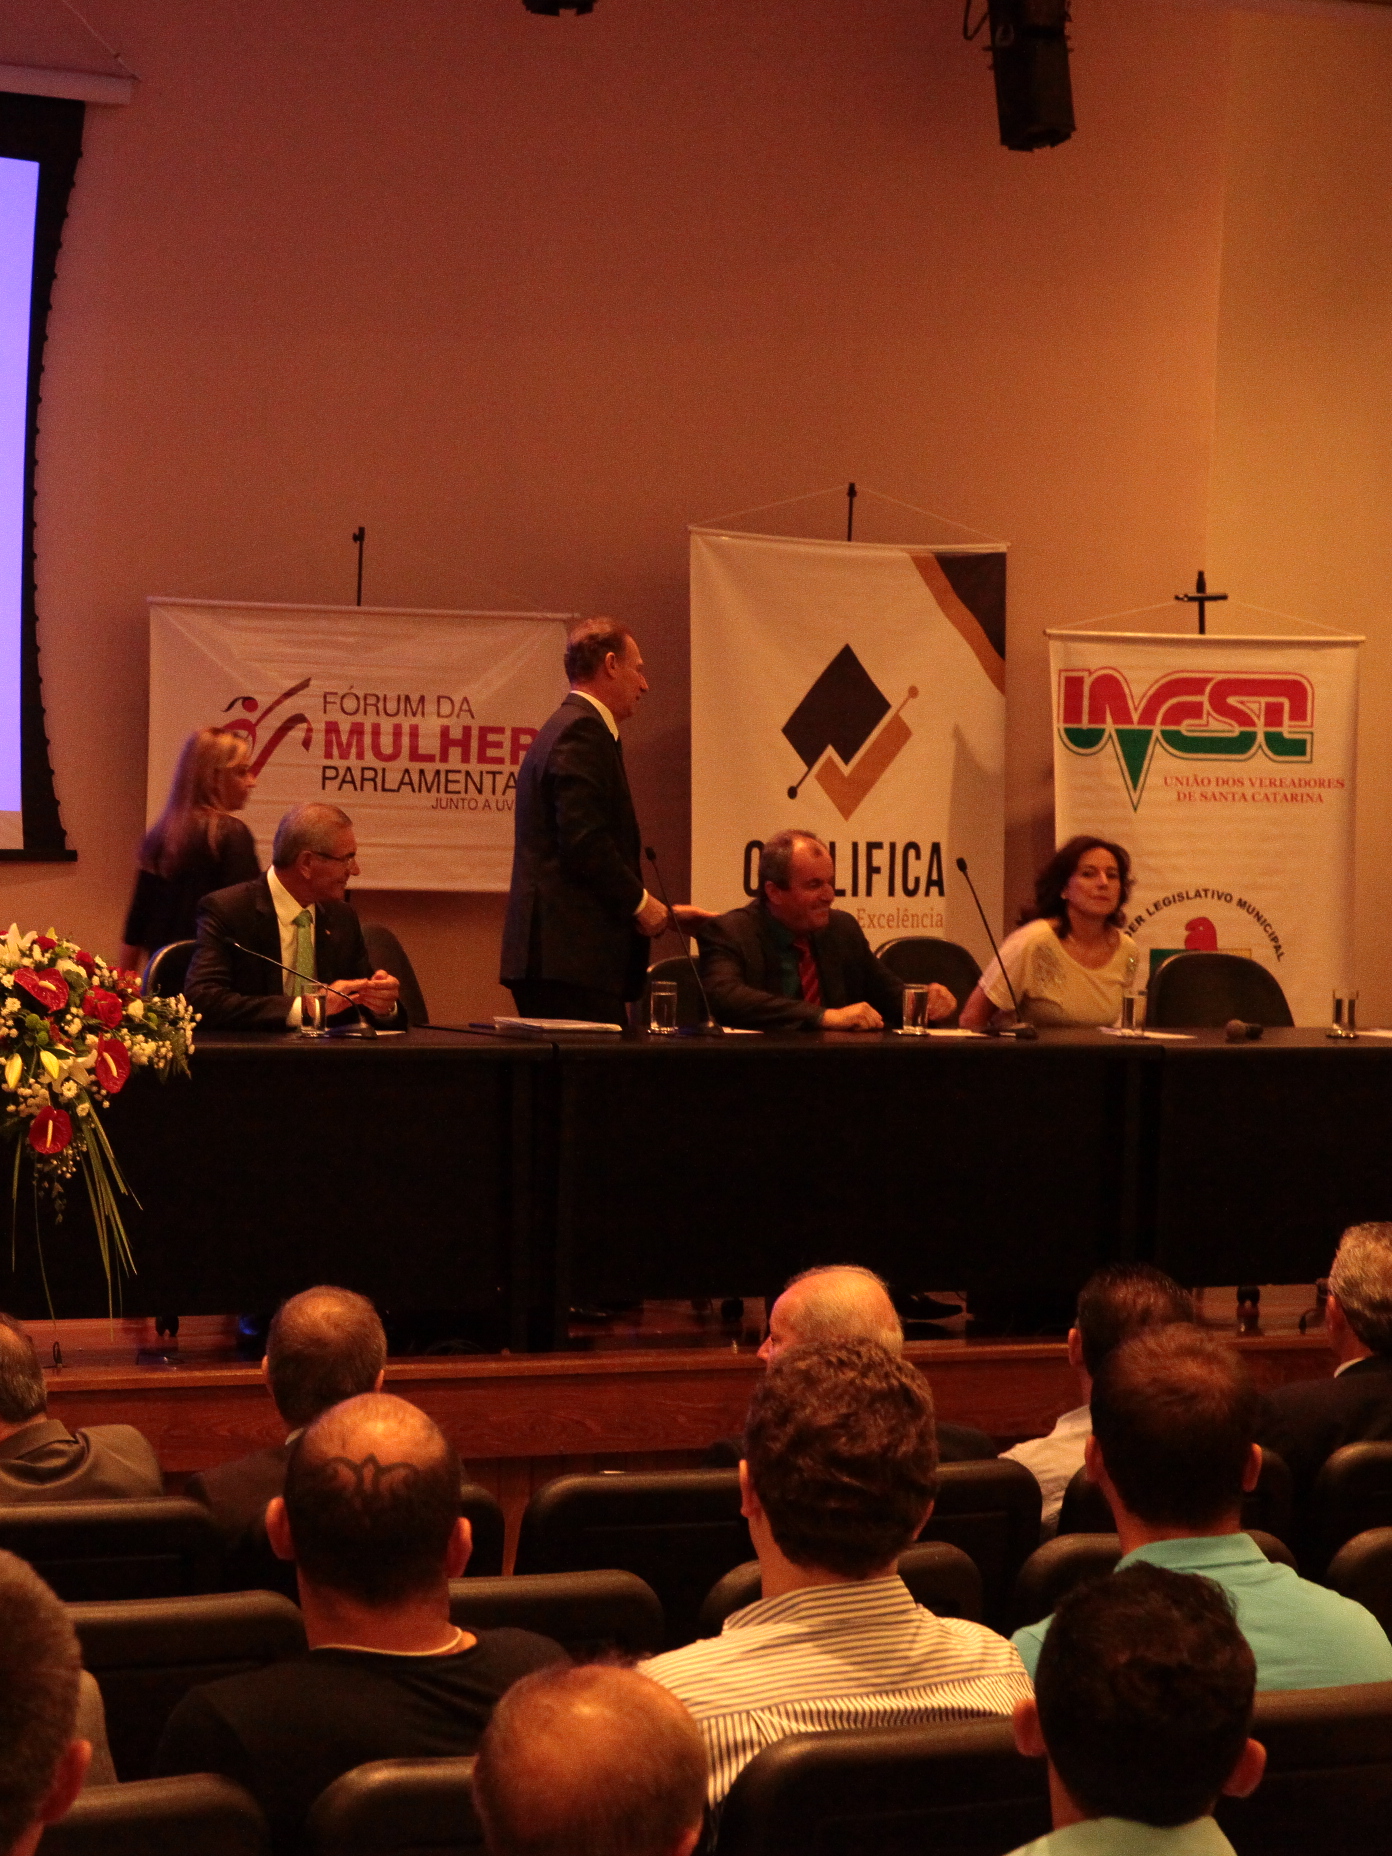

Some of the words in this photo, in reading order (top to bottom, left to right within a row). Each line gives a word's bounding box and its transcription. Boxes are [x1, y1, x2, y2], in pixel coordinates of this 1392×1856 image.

[323, 685, 425, 718] FÓRUM
[436, 695, 475, 720] DA
[321, 765, 517, 796] PARLAMENTA
[1163, 774, 1211, 787] UNIÃO
[1215, 776, 1245, 788] DOS
[1248, 777, 1346, 789] VEREADORES
[431, 797, 478, 811] JUNTO
[1176, 791, 1196, 801] DE
[1199, 791, 1248, 803] SANTA
[1251, 792, 1325, 804] CATARINA
[743, 840, 945, 897] QLIFICA
[1145, 888, 1234, 917] LEGISLATIVO
[1236, 897, 1286, 962] MUNICIPAL
